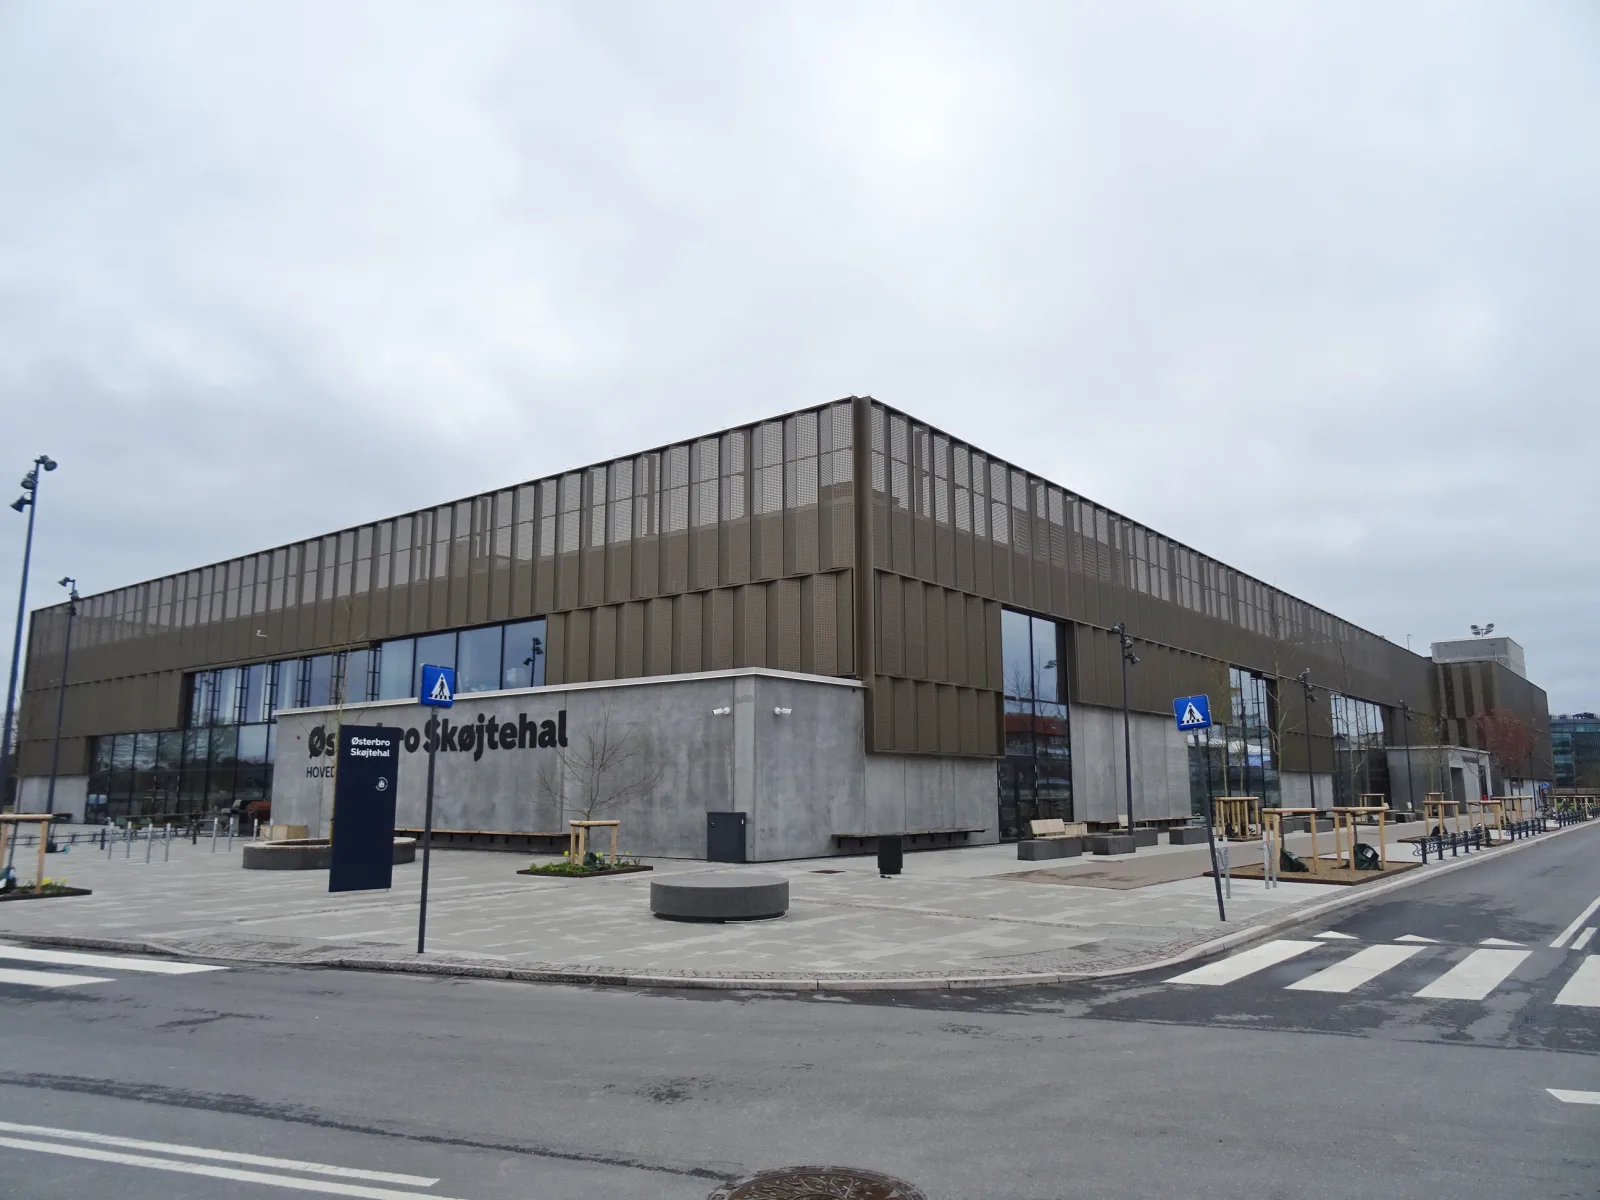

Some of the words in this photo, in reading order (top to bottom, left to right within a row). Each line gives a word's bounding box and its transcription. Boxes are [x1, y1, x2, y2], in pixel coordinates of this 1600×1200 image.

[423, 710, 568, 762] Skøjtehal
[351, 737, 391, 747] Østerbro
[350, 748, 390, 758] Skøjtehal
